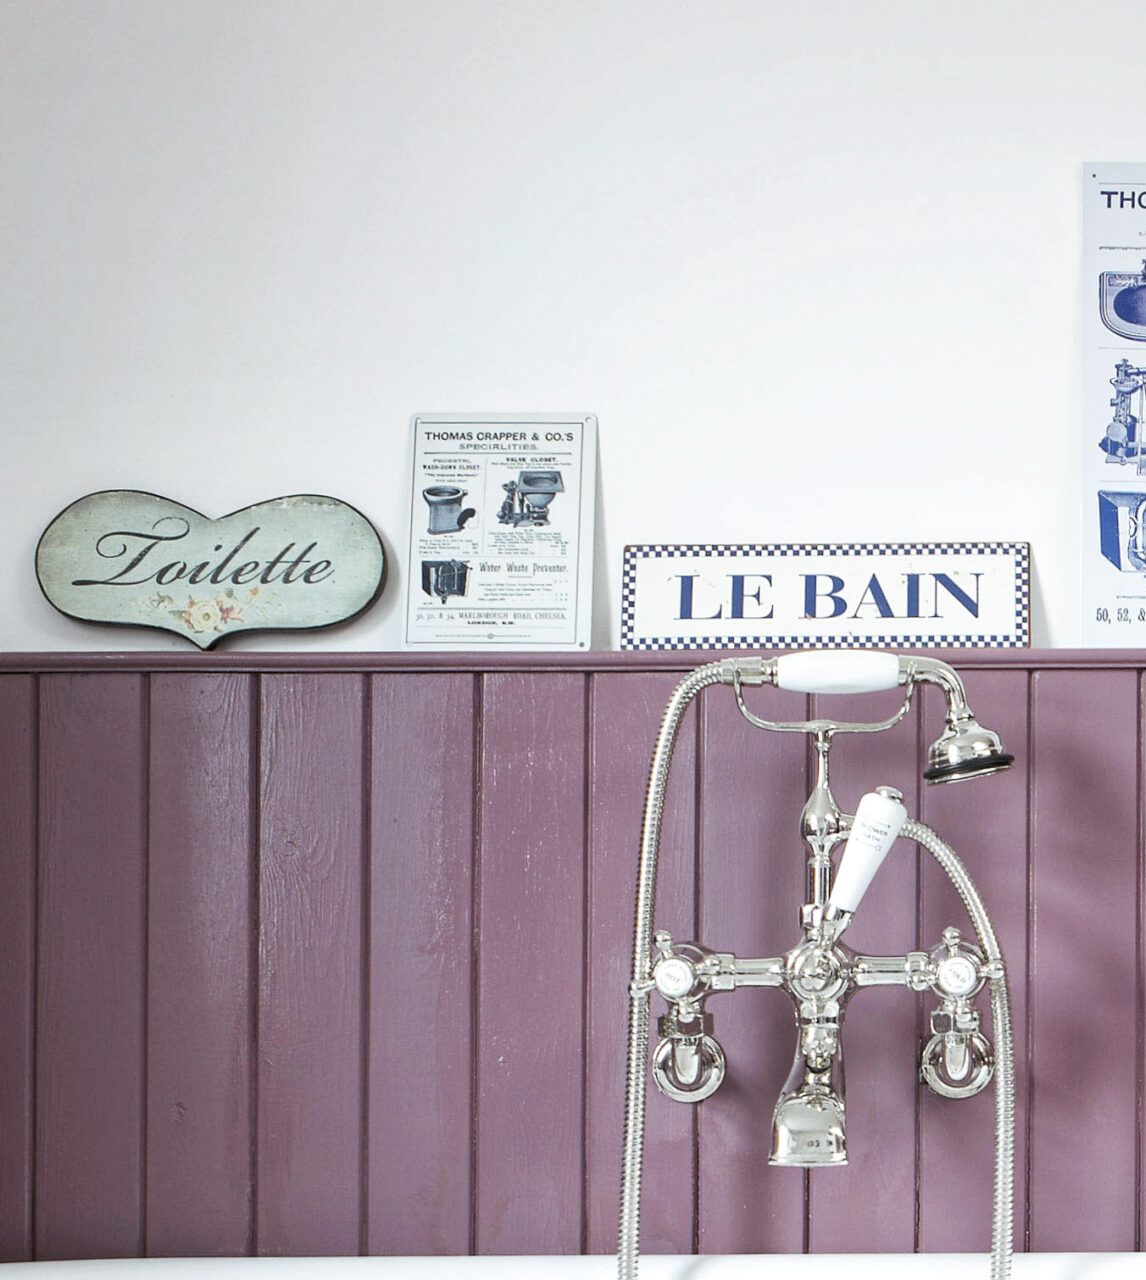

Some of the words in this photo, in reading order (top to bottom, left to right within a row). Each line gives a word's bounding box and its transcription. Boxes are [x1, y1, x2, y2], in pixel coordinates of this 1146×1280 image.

[424, 431, 474, 441] THOMAS
[476, 431, 527, 441] CRAPPER
[531, 432, 540, 441] &
[71, 516, 335, 586] Toilette
[673, 574, 774, 620] LE
[798, 573, 985, 620] BAIN
[459, 611, 509, 620] MARLBOROUGH
[1096, 607, 1112, 625] 50,
[1116, 607, 1132, 624] 52,
[1137, 607, 1146, 622] &
